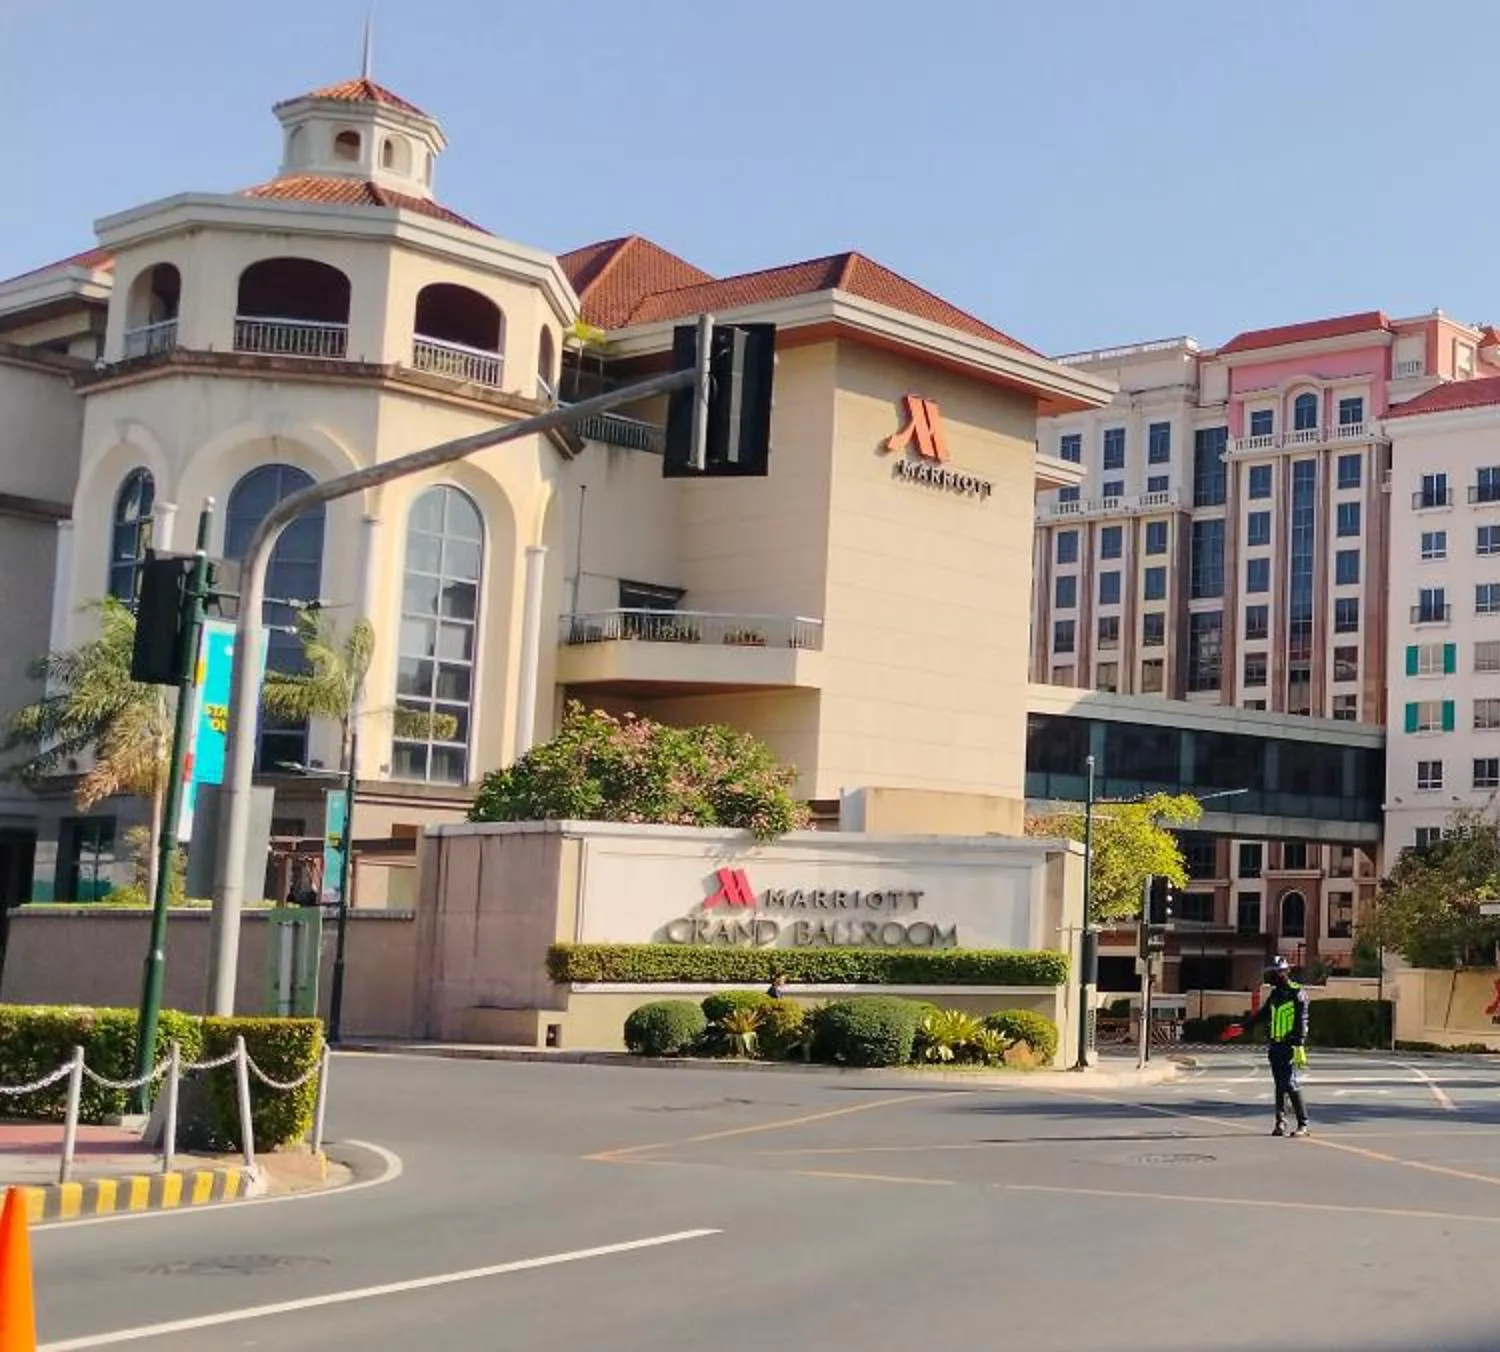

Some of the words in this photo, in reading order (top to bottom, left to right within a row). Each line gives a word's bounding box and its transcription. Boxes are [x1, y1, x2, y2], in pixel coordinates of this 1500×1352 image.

[895, 459, 993, 497] MARRIOTT
[763, 888, 924, 910] MARRIOTT
[665, 916, 779, 945] GRAND
[791, 918, 958, 946] BALLROOM
